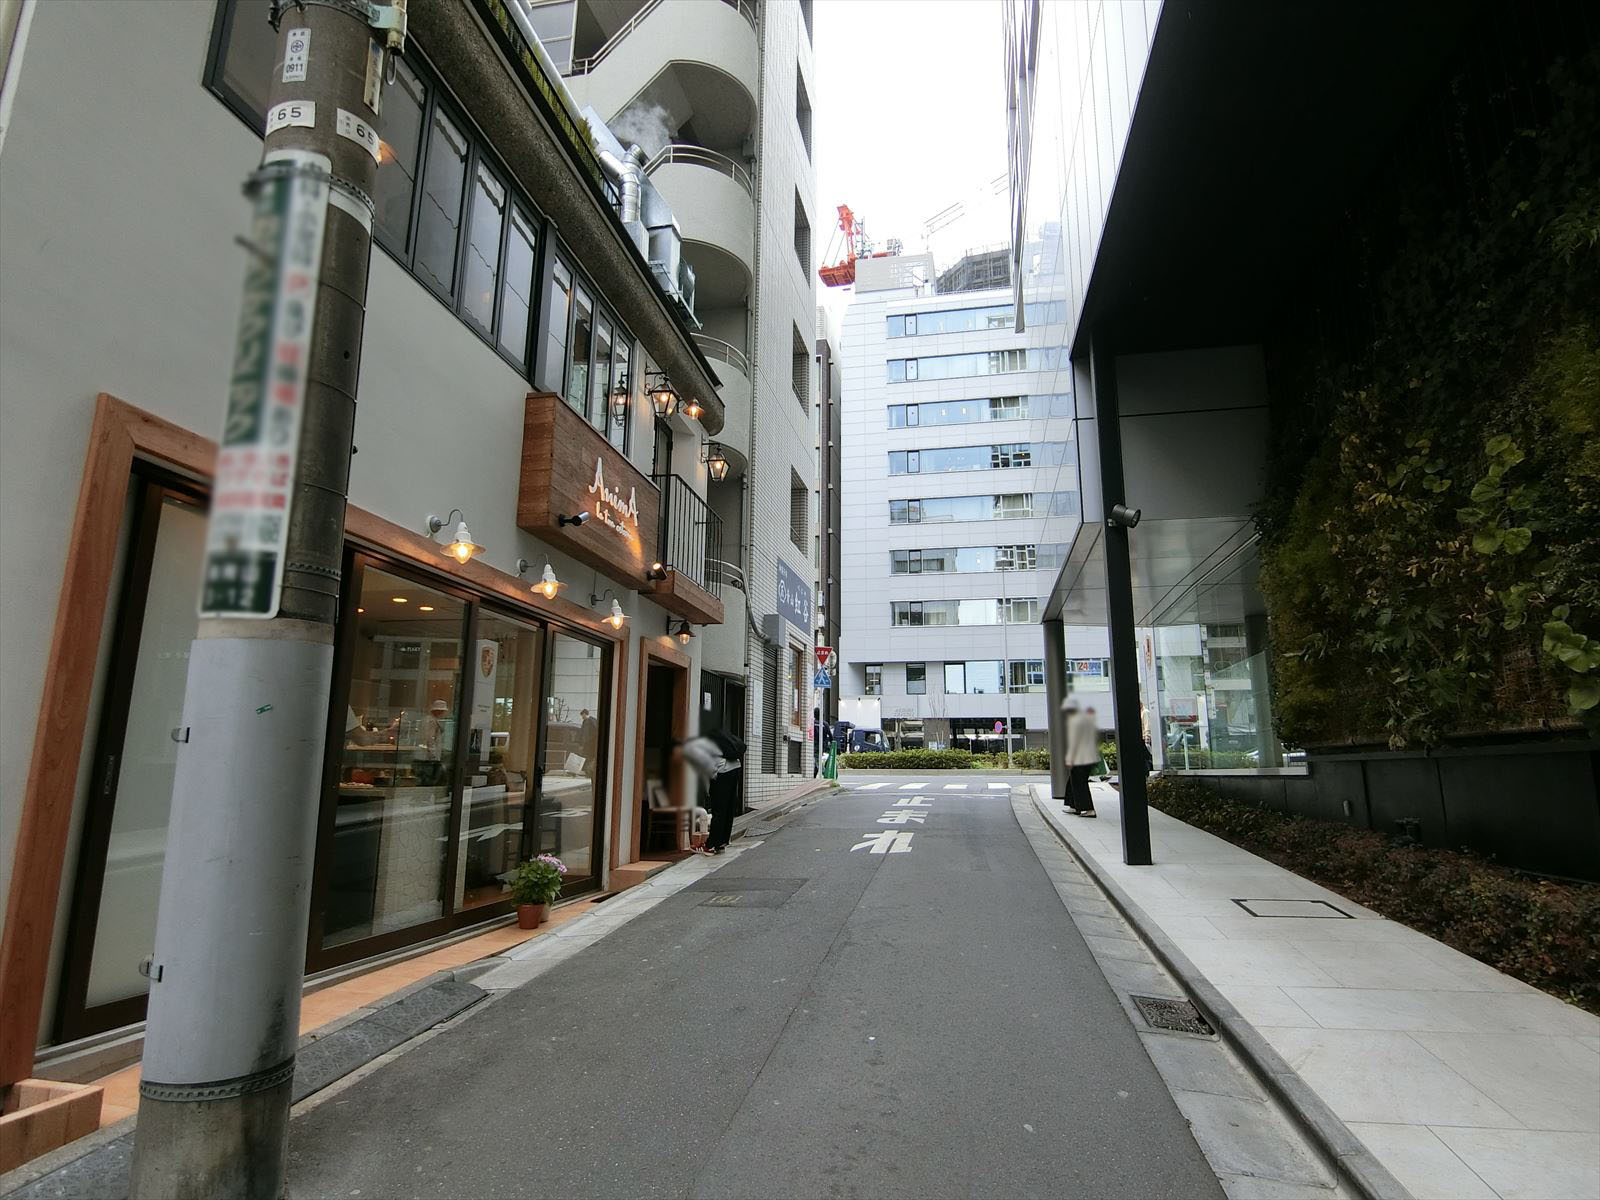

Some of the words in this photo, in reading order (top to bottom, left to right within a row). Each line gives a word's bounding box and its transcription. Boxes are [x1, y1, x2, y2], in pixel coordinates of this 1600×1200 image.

[286, 63, 304, 73] 0911
[277, 106, 302, 121] 65
[356, 123, 375, 146] 65
[588, 456, 639, 527] AnimA
[850, 796, 935, 854] 止まれ
